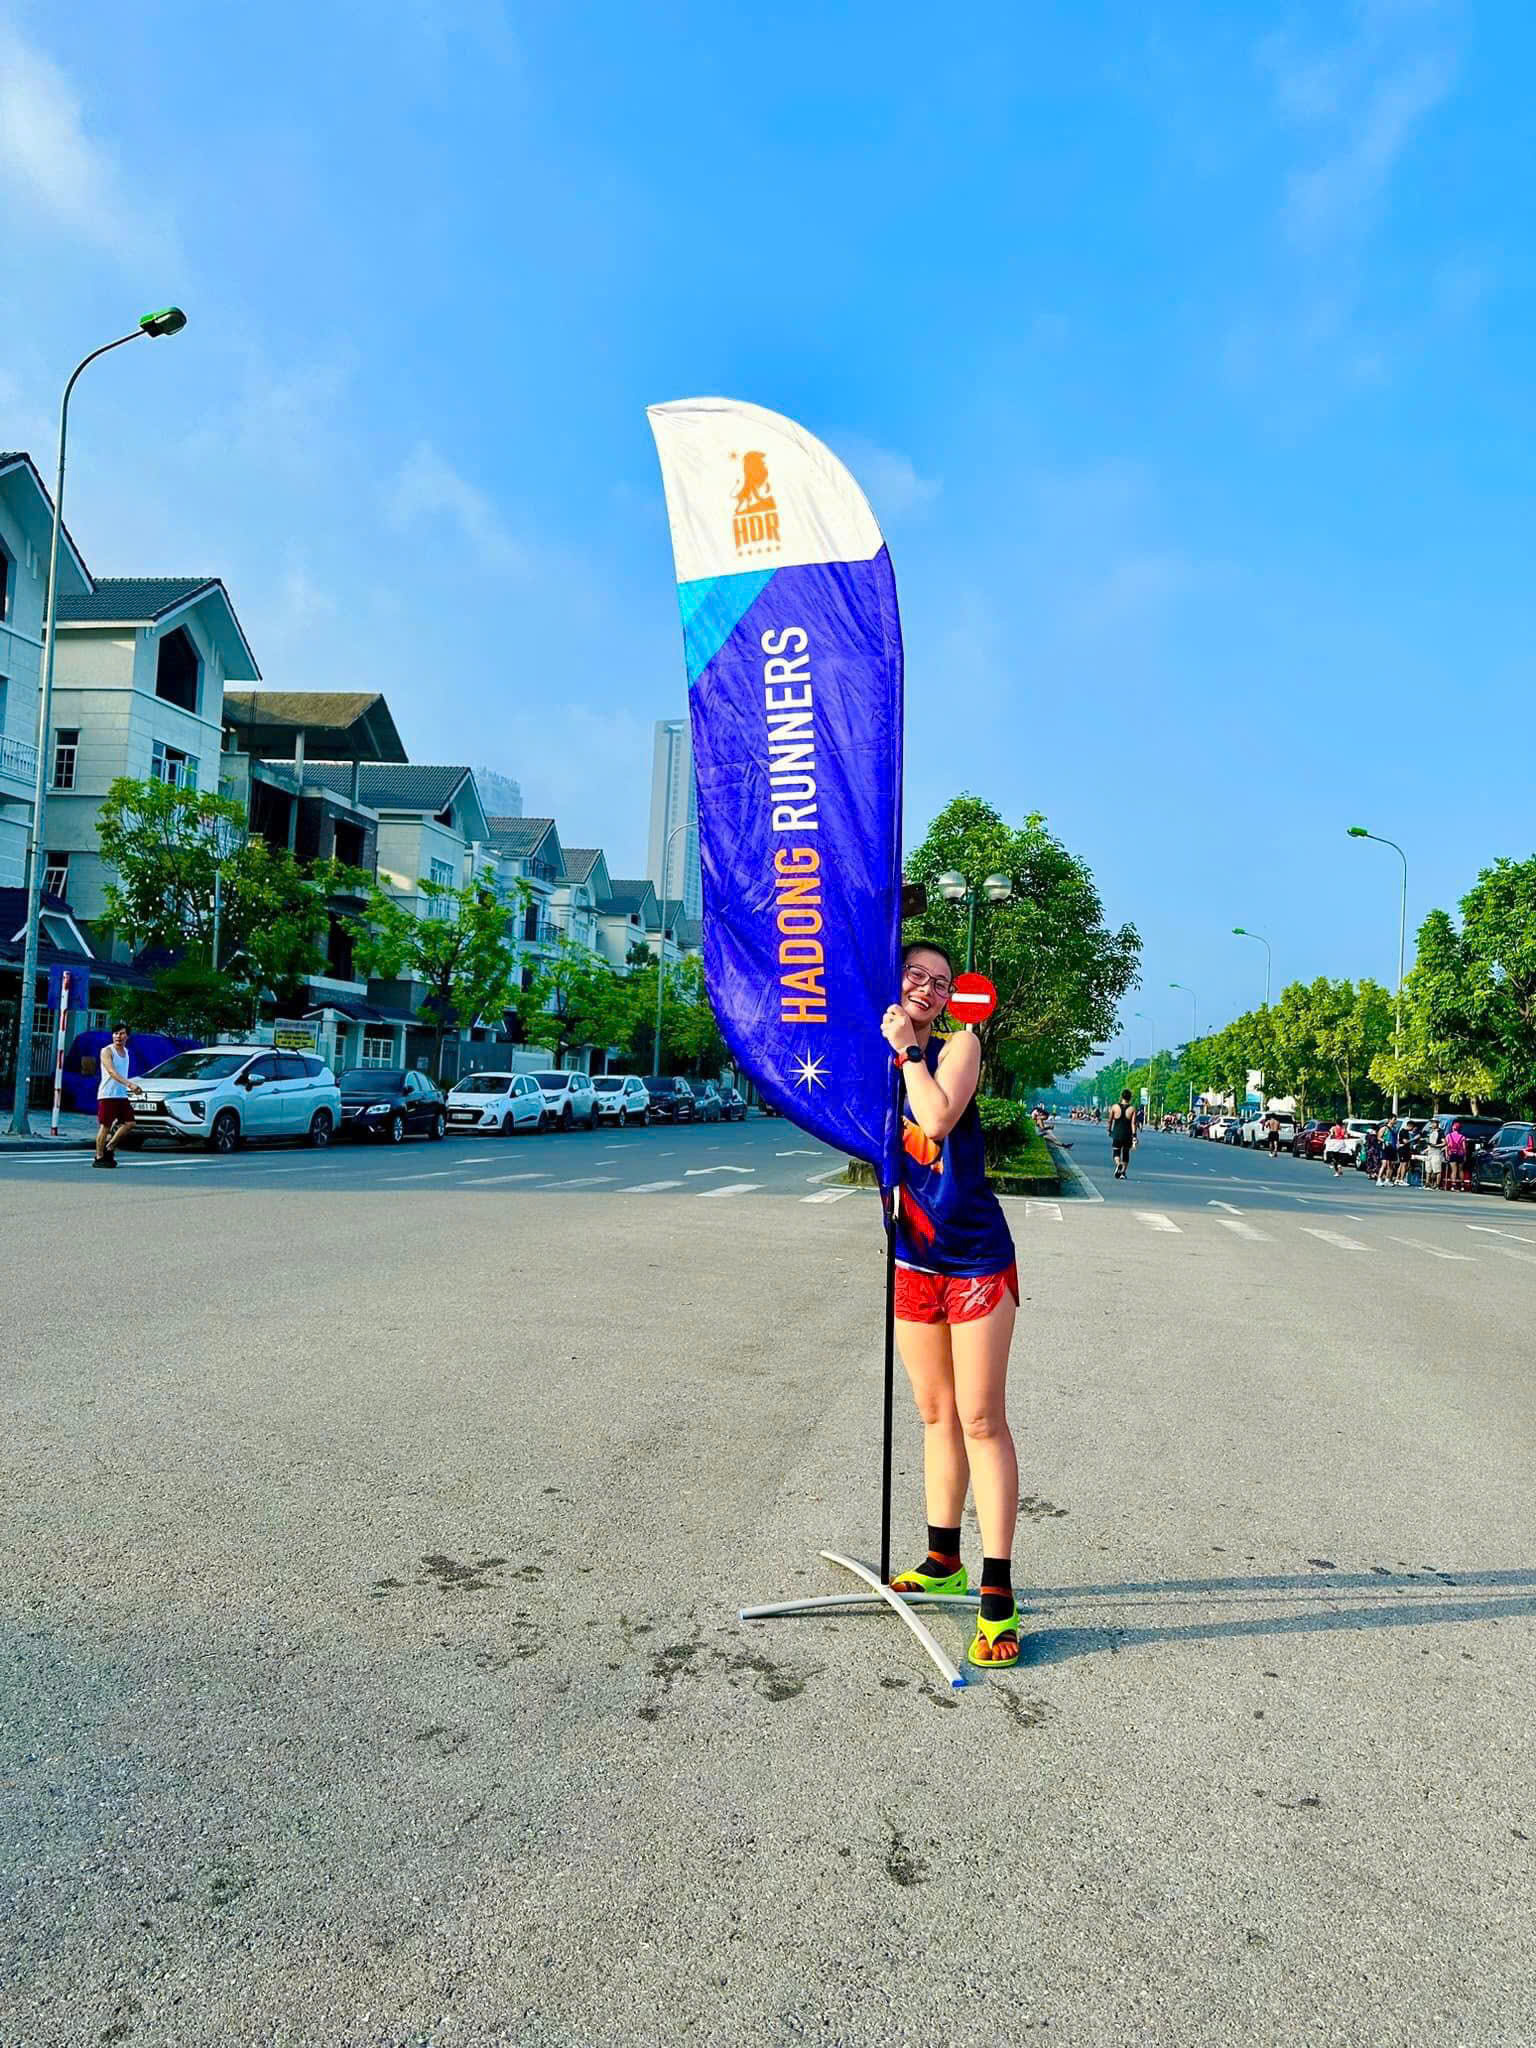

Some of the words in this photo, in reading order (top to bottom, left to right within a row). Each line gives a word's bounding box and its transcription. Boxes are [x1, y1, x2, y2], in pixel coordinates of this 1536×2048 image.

[733, 512, 781, 549] HDR
[761, 626, 819, 832] RUNNERS
[774, 847, 828, 1023] HADONG
